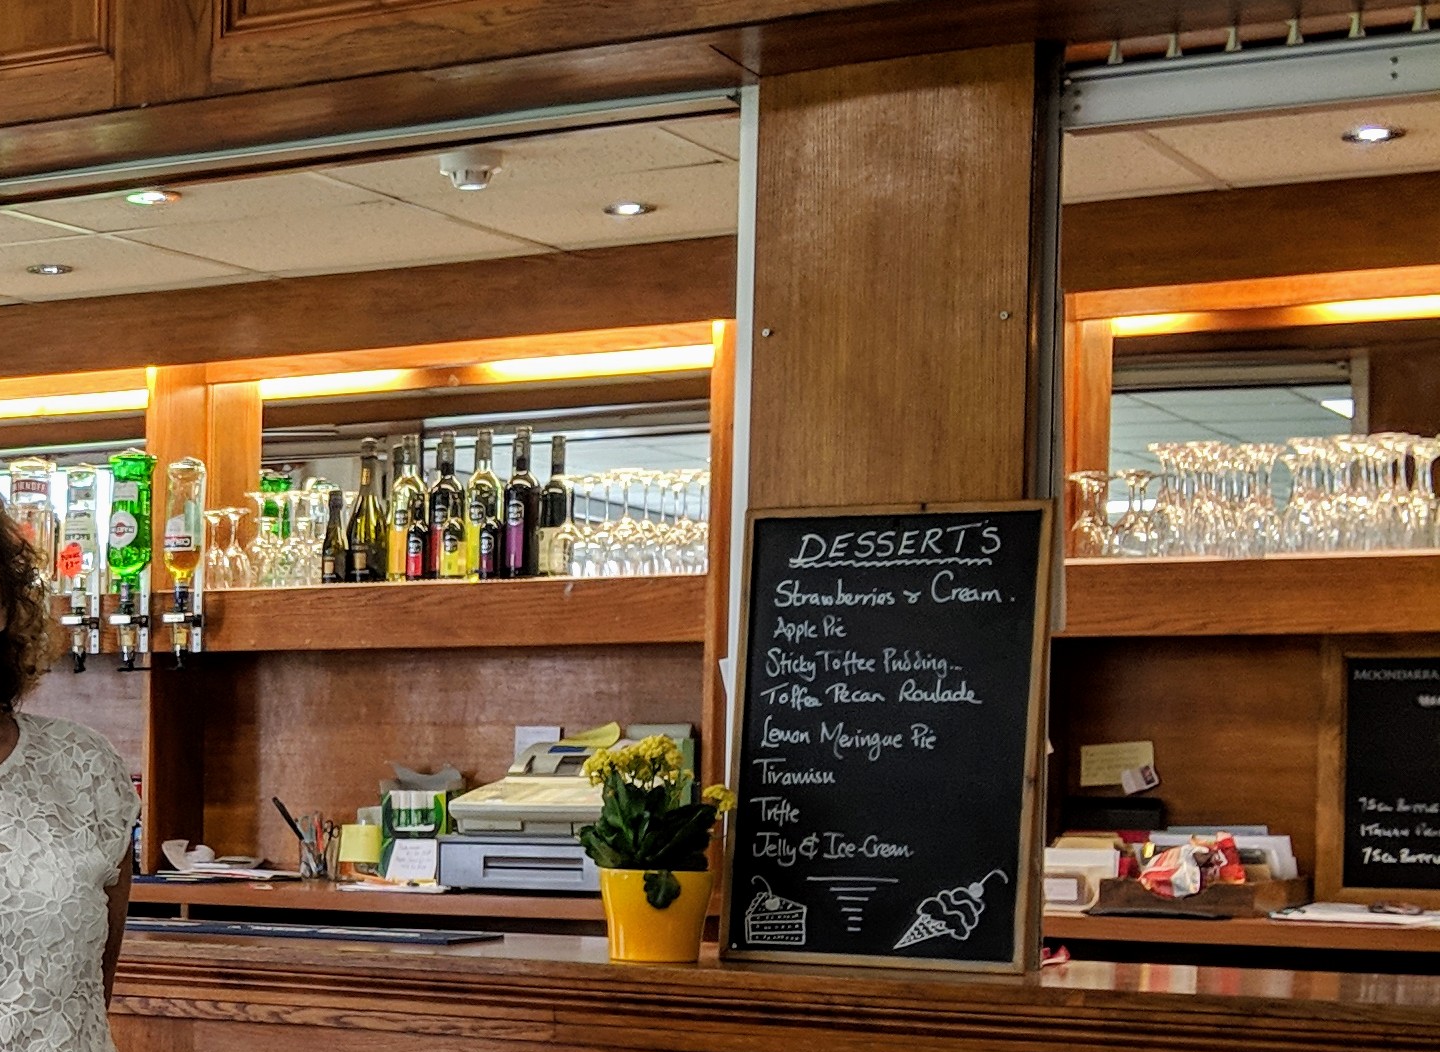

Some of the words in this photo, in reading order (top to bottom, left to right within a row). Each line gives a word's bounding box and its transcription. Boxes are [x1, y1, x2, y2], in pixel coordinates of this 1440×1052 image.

[792, 521, 1002, 564] DESSERTS
[774, 579, 896, 608] Strawberries
[773, 616, 818, 644] Apple
[823, 614, 847, 638] Pie
[765, 647, 817, 681] Sticky
[816, 650, 876, 676] Toffee
[760, 682, 823, 711] Toffee
[825, 682, 885, 704] Pecan
[899, 679, 983, 705] Roulade
[761, 715, 810, 748] Lemon
[821, 722, 904, 761] Meringue
[911, 722, 937, 750] Pie
[752, 758, 836, 785] Tiramisu
[750, 796, 800, 827] Trifle
[752, 832, 796, 867] Jelly
[799, 832, 820, 860] &
